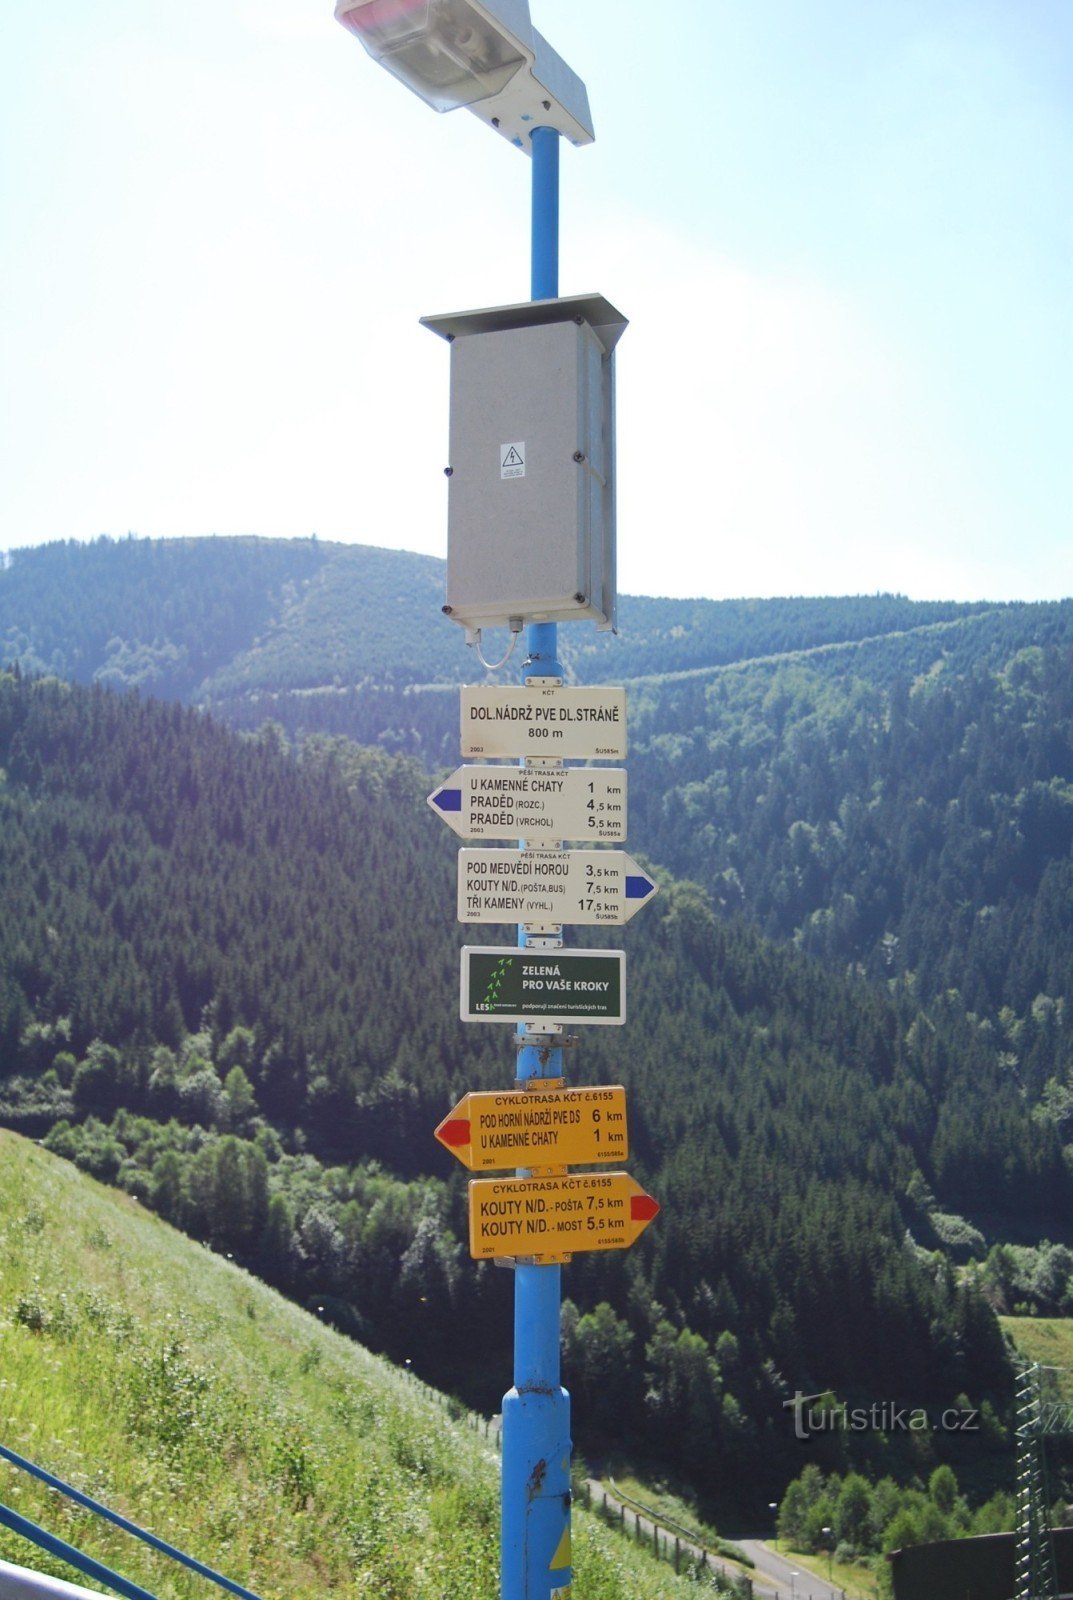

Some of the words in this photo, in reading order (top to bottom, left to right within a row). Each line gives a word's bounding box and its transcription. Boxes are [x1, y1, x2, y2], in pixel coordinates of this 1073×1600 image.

[470, 704, 533, 720] DOL.NÁDRŽ
[536, 708, 556, 721] PVE
[560, 706, 619, 722] DL.STRÁNĚ
[528, 728, 549, 738] 800
[552, 730, 563, 738] m
[471, 779, 478, 789] U
[481, 777, 528, 792] KAMENNÉ
[531, 781, 564, 792] CHATY
[588, 782, 594, 793] 1
[607, 786, 621, 794] km
[470, 794, 514, 808] PRADĚD
[515, 802, 545, 810] (ROZC.)
[587, 800, 605, 812] 4,5
[607, 803, 621, 811] km
[470, 811, 514, 825] PRADĚD
[516, 818, 553, 827] (VRCHOL)
[588, 816, 605, 828] 5,5
[607, 819, 621, 828] km
[467, 862, 487, 874] POD
[490, 861, 532, 875] MEDVĚDÍ
[535, 864, 569, 875] HOROU
[586, 865, 602, 877] 3,5
[604, 869, 618, 877] km
[467, 880, 499, 891] KOUTY
[586, 882, 601, 894] 7,5
[467, 894, 481, 908] TŘI
[484, 898, 524, 909] KAMENY
[527, 902, 553, 911] (VYHL.)
[579, 900, 601, 912] 17,5
[604, 903, 619, 911] km
[522, 964, 560, 976] ZELENÁ
[522, 981, 544, 990] PRO
[546, 979, 571, 990] VAŠE
[574, 982, 609, 991] KROKY
[495, 1095, 561, 1106] CYKLOTRASA
[585, 1092, 613, 1101] č.6155
[480, 1114, 497, 1128] POD
[499, 1110, 522, 1127] HORNÍ
[524, 1109, 551, 1125] NÁDRŽÍ
[554, 1112, 567, 1124] PVE
[592, 1109, 600, 1123] 6
[607, 1112, 622, 1121] km
[481, 1136, 487, 1148] U
[490, 1130, 529, 1148] KAMENNÉ
[532, 1131, 559, 1146] CHATY
[594, 1129, 600, 1142] 1
[609, 1132, 623, 1141] km
[493, 1183, 559, 1194] CYKLOTRASA
[562, 1180, 580, 1189] KČT
[583, 1179, 612, 1188] č.6155
[481, 1201, 522, 1216] KOUTY
[555, 1201, 583, 1211] POŠTA
[586, 1196, 604, 1210] 7,5
[608, 1199, 624, 1207] km
[481, 1220, 523, 1237] KOUTY
[557, 1220, 582, 1231] MOST
[586, 1217, 605, 1230] 5,5
[608, 1219, 624, 1228] km
